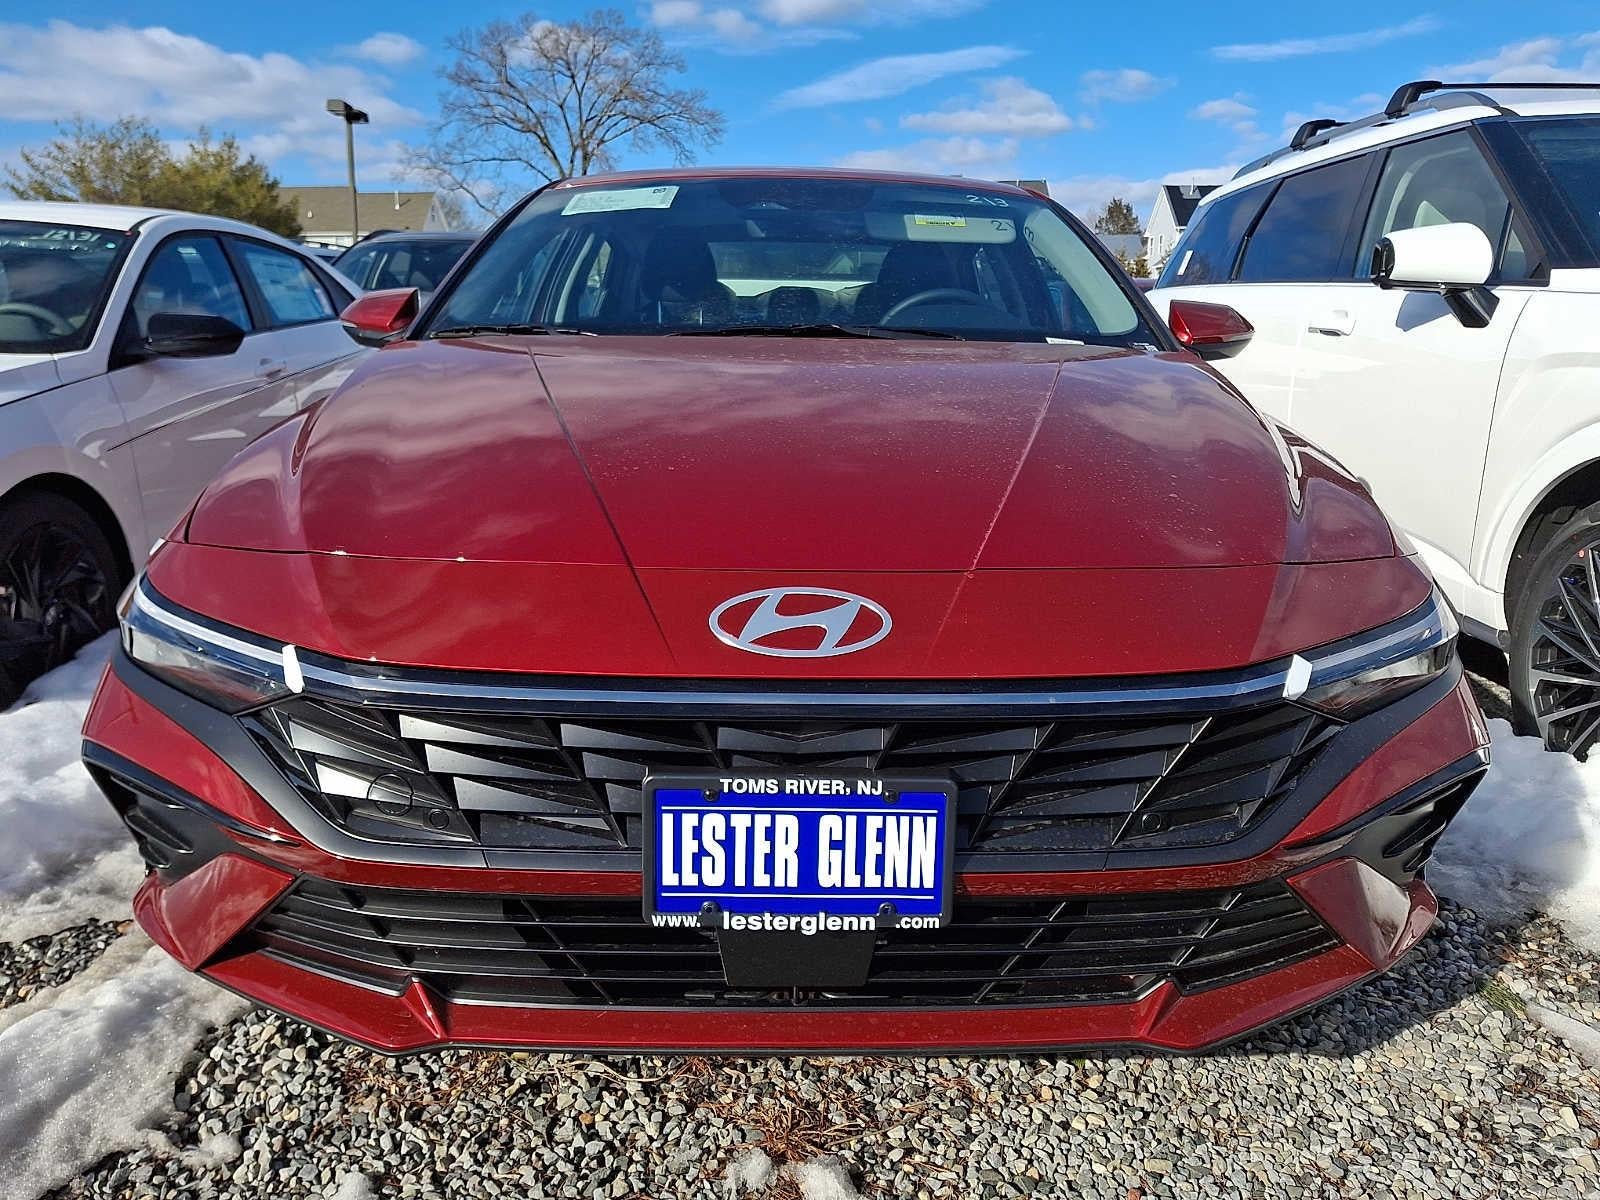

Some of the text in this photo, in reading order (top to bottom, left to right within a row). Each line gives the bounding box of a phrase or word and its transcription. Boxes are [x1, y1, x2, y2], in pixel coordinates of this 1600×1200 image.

[719, 778, 883, 796] TOMS RIVER, NJ
[661, 812, 938, 889] LESTER GLENN
[651, 911, 941, 936] www. lesterglenn .com
